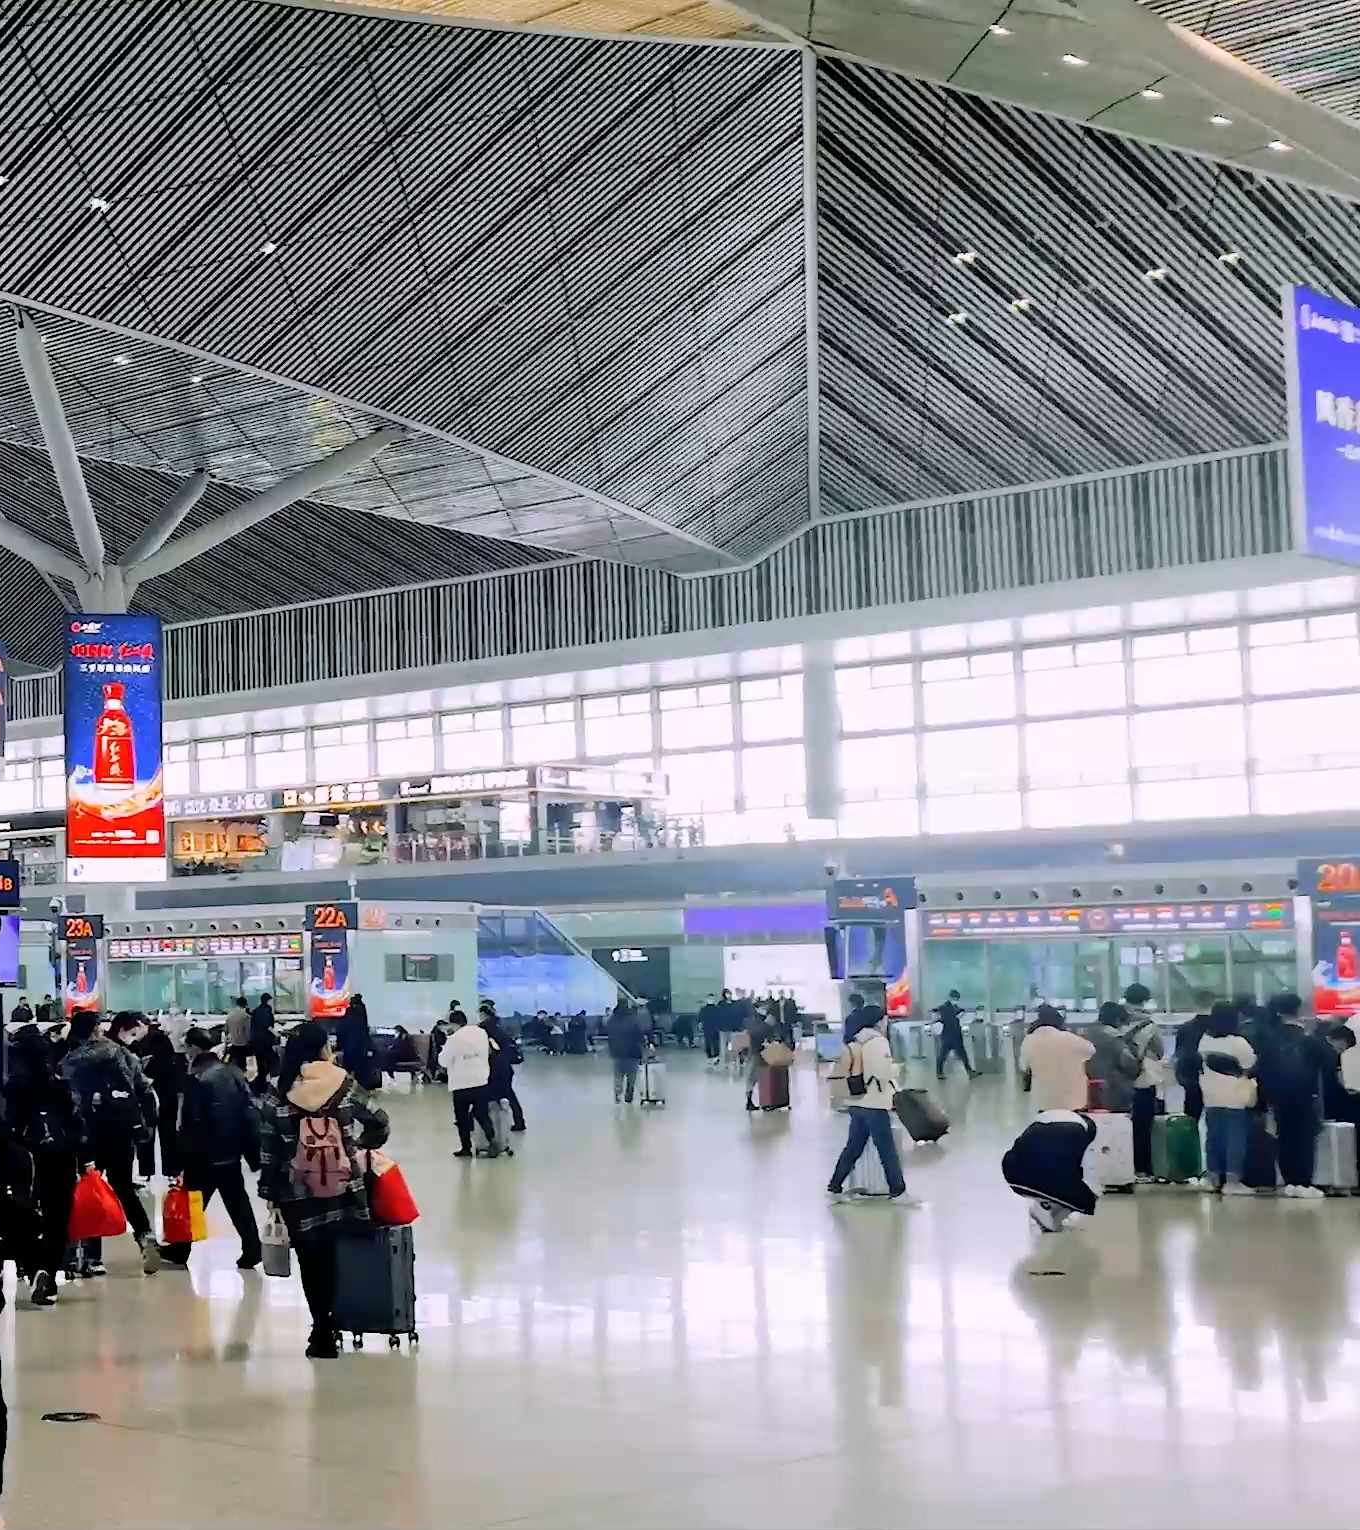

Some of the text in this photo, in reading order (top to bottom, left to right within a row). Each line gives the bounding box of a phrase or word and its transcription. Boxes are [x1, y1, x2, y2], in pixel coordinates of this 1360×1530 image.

[1317, 863, 1360, 892] 20
[65, 919, 92, 937] 23A
[314, 907, 348, 928] 22A
